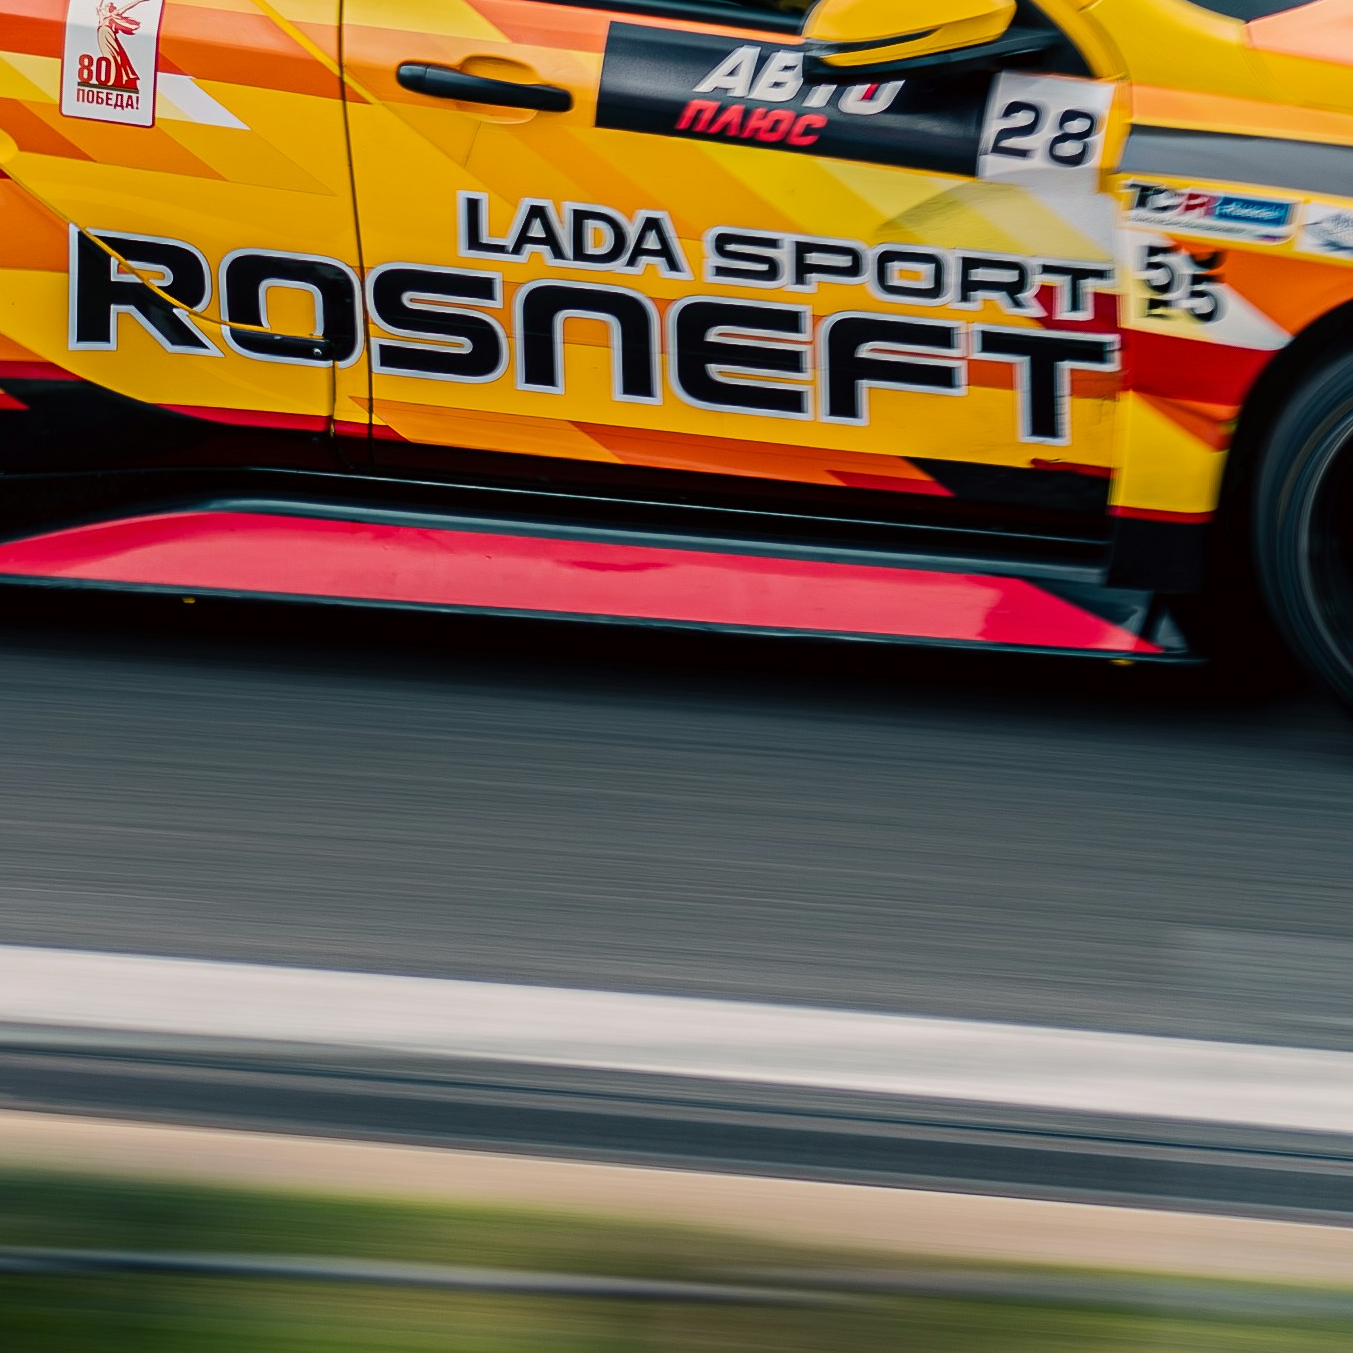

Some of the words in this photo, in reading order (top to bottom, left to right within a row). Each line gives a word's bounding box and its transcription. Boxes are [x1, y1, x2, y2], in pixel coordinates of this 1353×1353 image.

[78, 54, 113, 85] 80
[76, 88, 140, 111] ПОБЕДА!
[675, 99, 829, 146] ПЛЮС
[989, 100, 1096, 167] 28
[457, 189, 693, 280] LADA
[704, 224, 1117, 322] SPORT
[67, 222, 1123, 446] ROSNEFT
